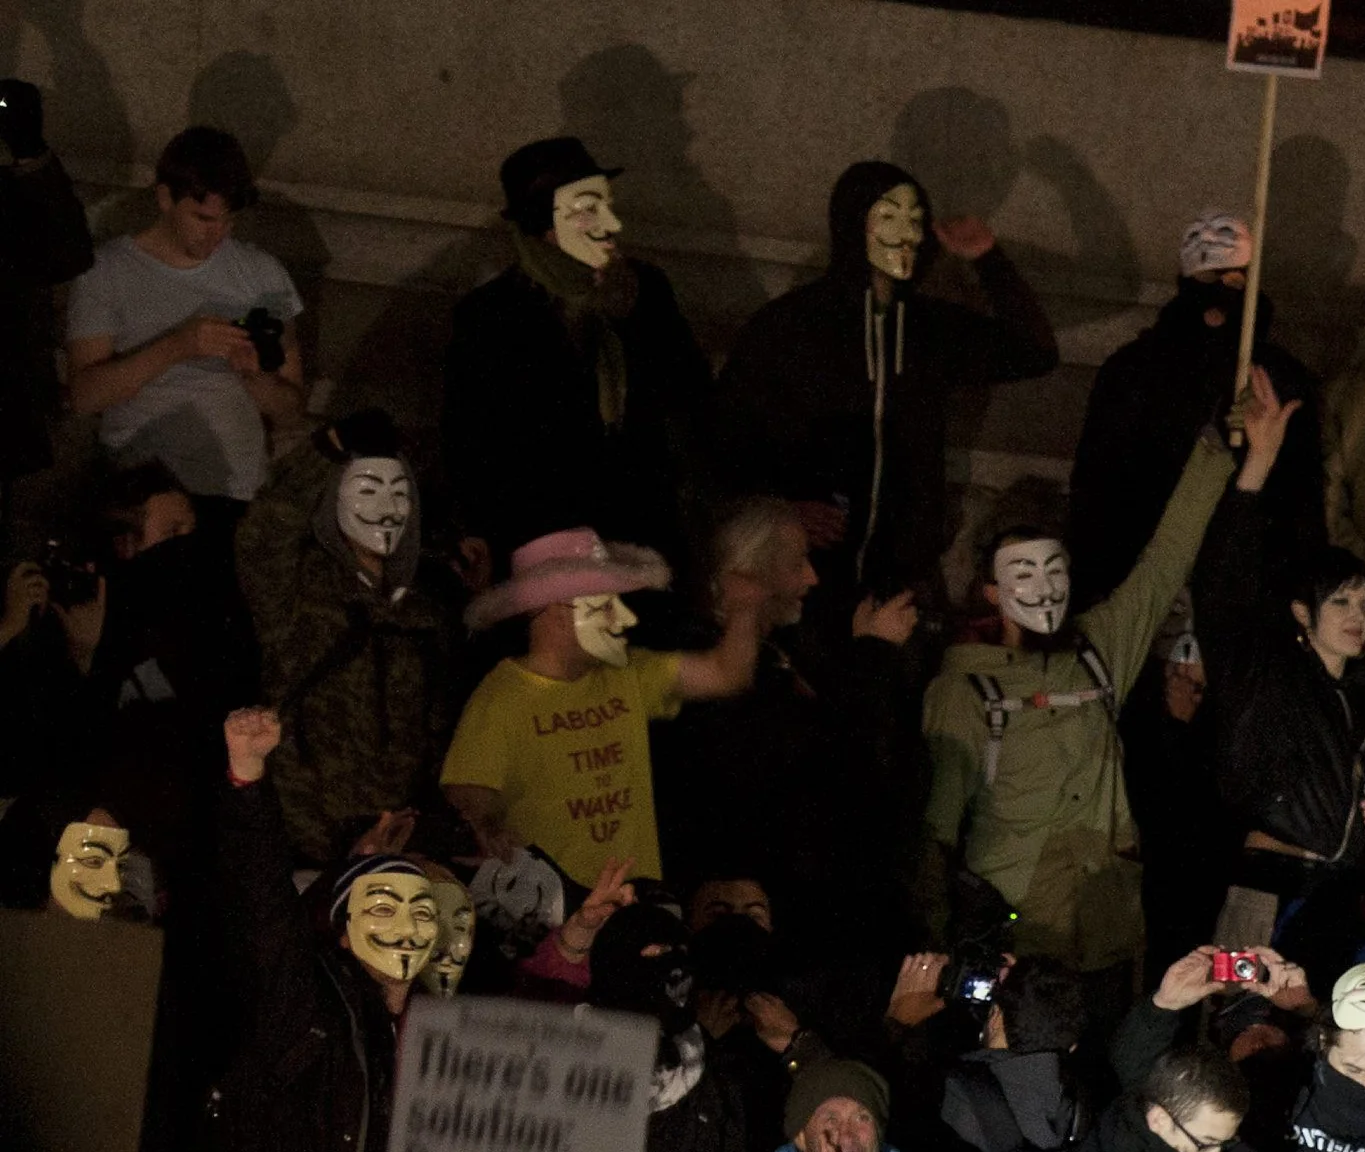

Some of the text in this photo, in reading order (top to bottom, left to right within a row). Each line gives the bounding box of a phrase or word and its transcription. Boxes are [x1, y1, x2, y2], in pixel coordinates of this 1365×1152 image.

[533, 697, 630, 736] LABOUR
[568, 742, 622, 771] TIME
[567, 788, 632, 819] WAKE
[590, 820, 619, 842] UP
[418, 1031, 635, 1106] There's one
